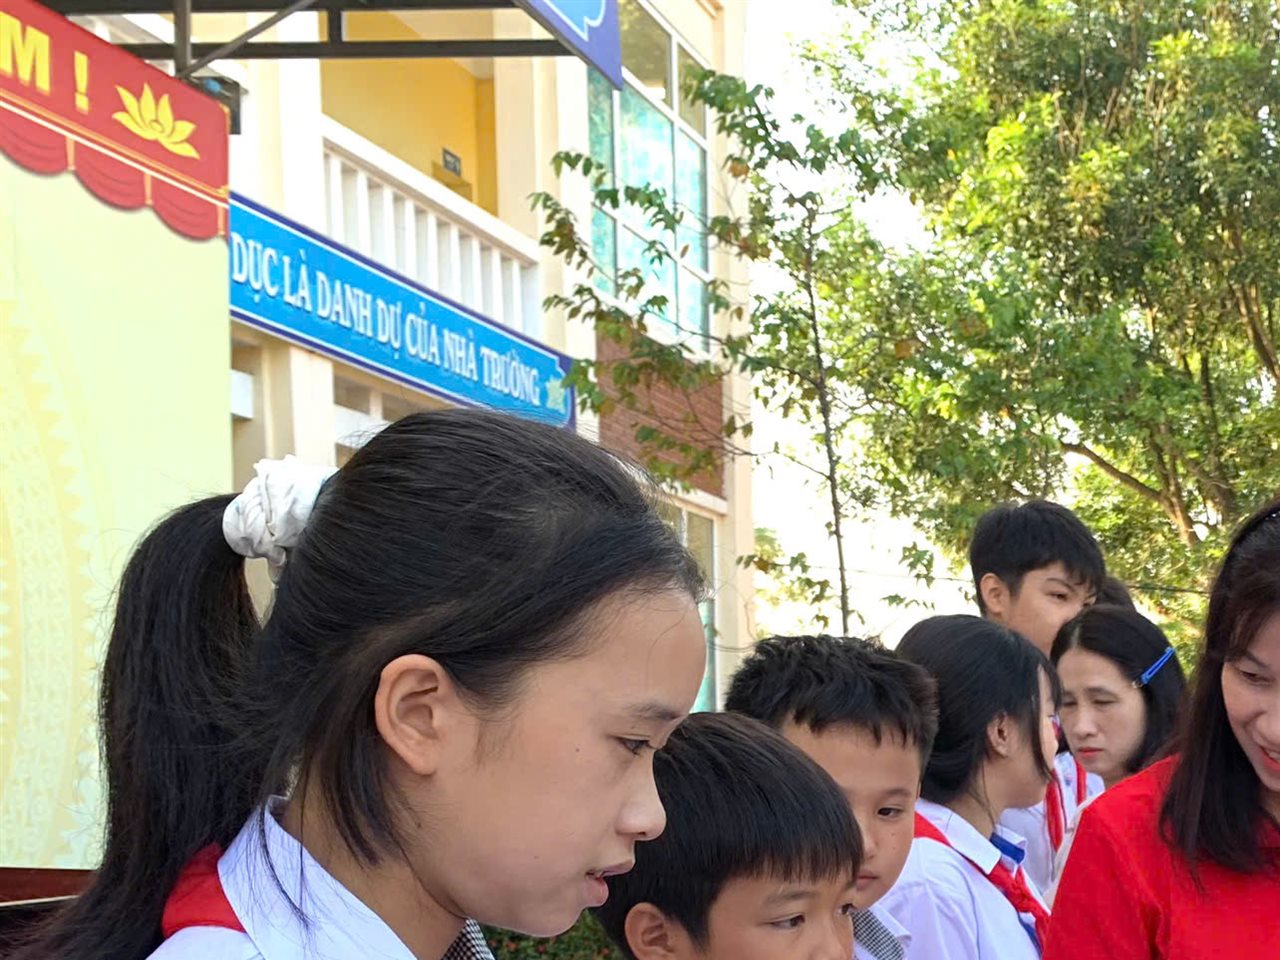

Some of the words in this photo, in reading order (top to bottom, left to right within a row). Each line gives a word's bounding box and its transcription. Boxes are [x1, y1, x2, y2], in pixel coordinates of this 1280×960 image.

[74, 50, 88, 114] !
[231, 231, 279, 303] DỤC
[282, 248, 312, 313] LÀ
[316, 270, 373, 338] DANH
[405, 301, 440, 366] CỦA
[443, 328, 478, 381] NHÀ
[480, 346, 540, 406] TRƯỜNG
